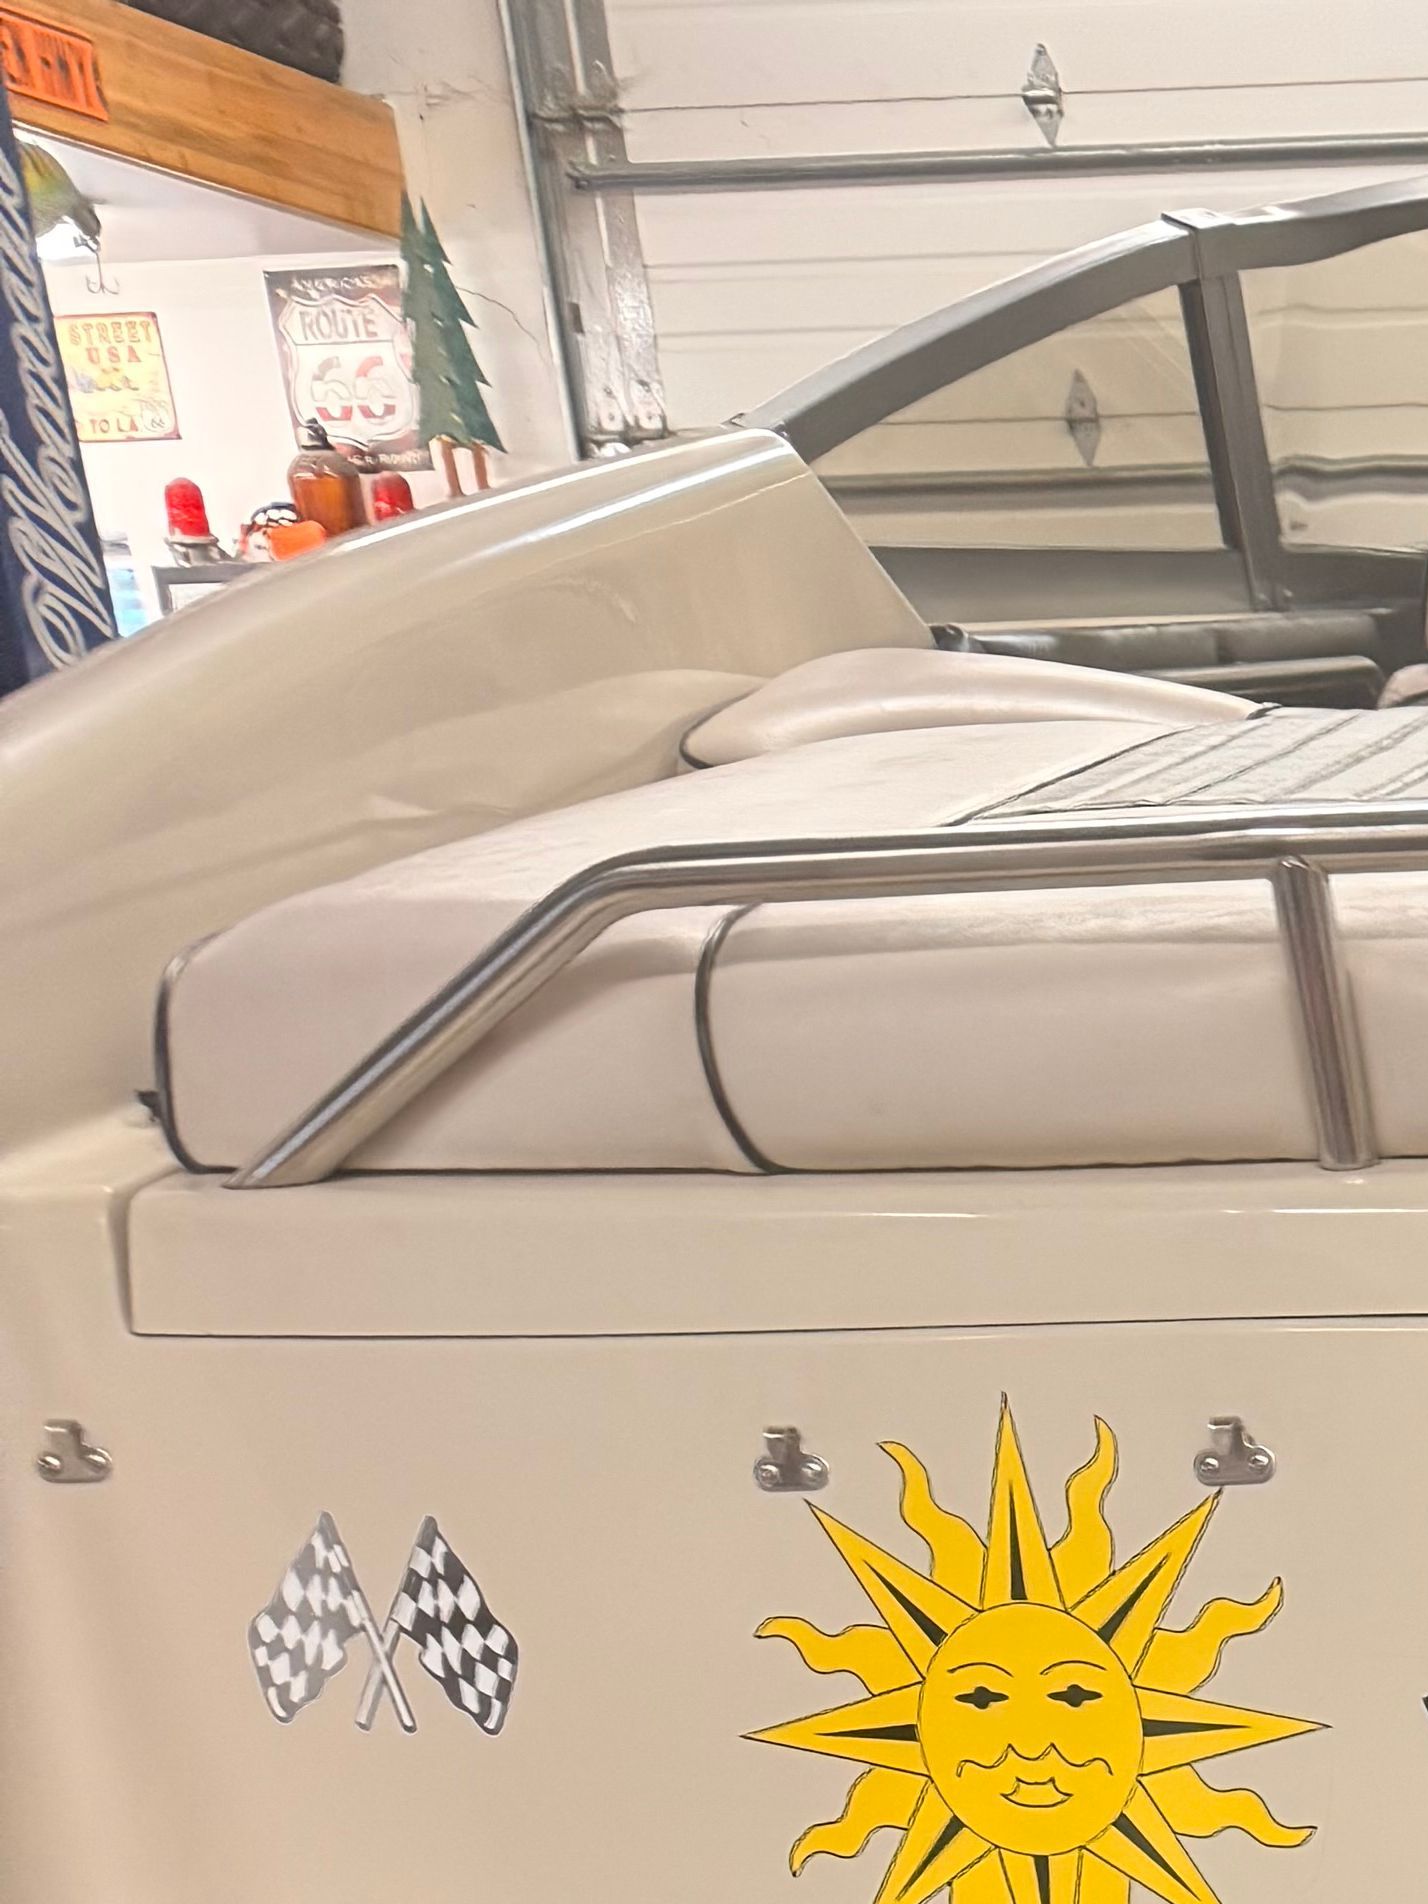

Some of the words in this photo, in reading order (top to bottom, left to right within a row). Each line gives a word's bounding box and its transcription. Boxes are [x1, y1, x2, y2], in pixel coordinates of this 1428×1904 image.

[69, 320, 153, 346] STREET
[299, 308, 379, 341] ROUTE
[85, 345, 142, 366] USA
[310, 355, 398, 428] 66
